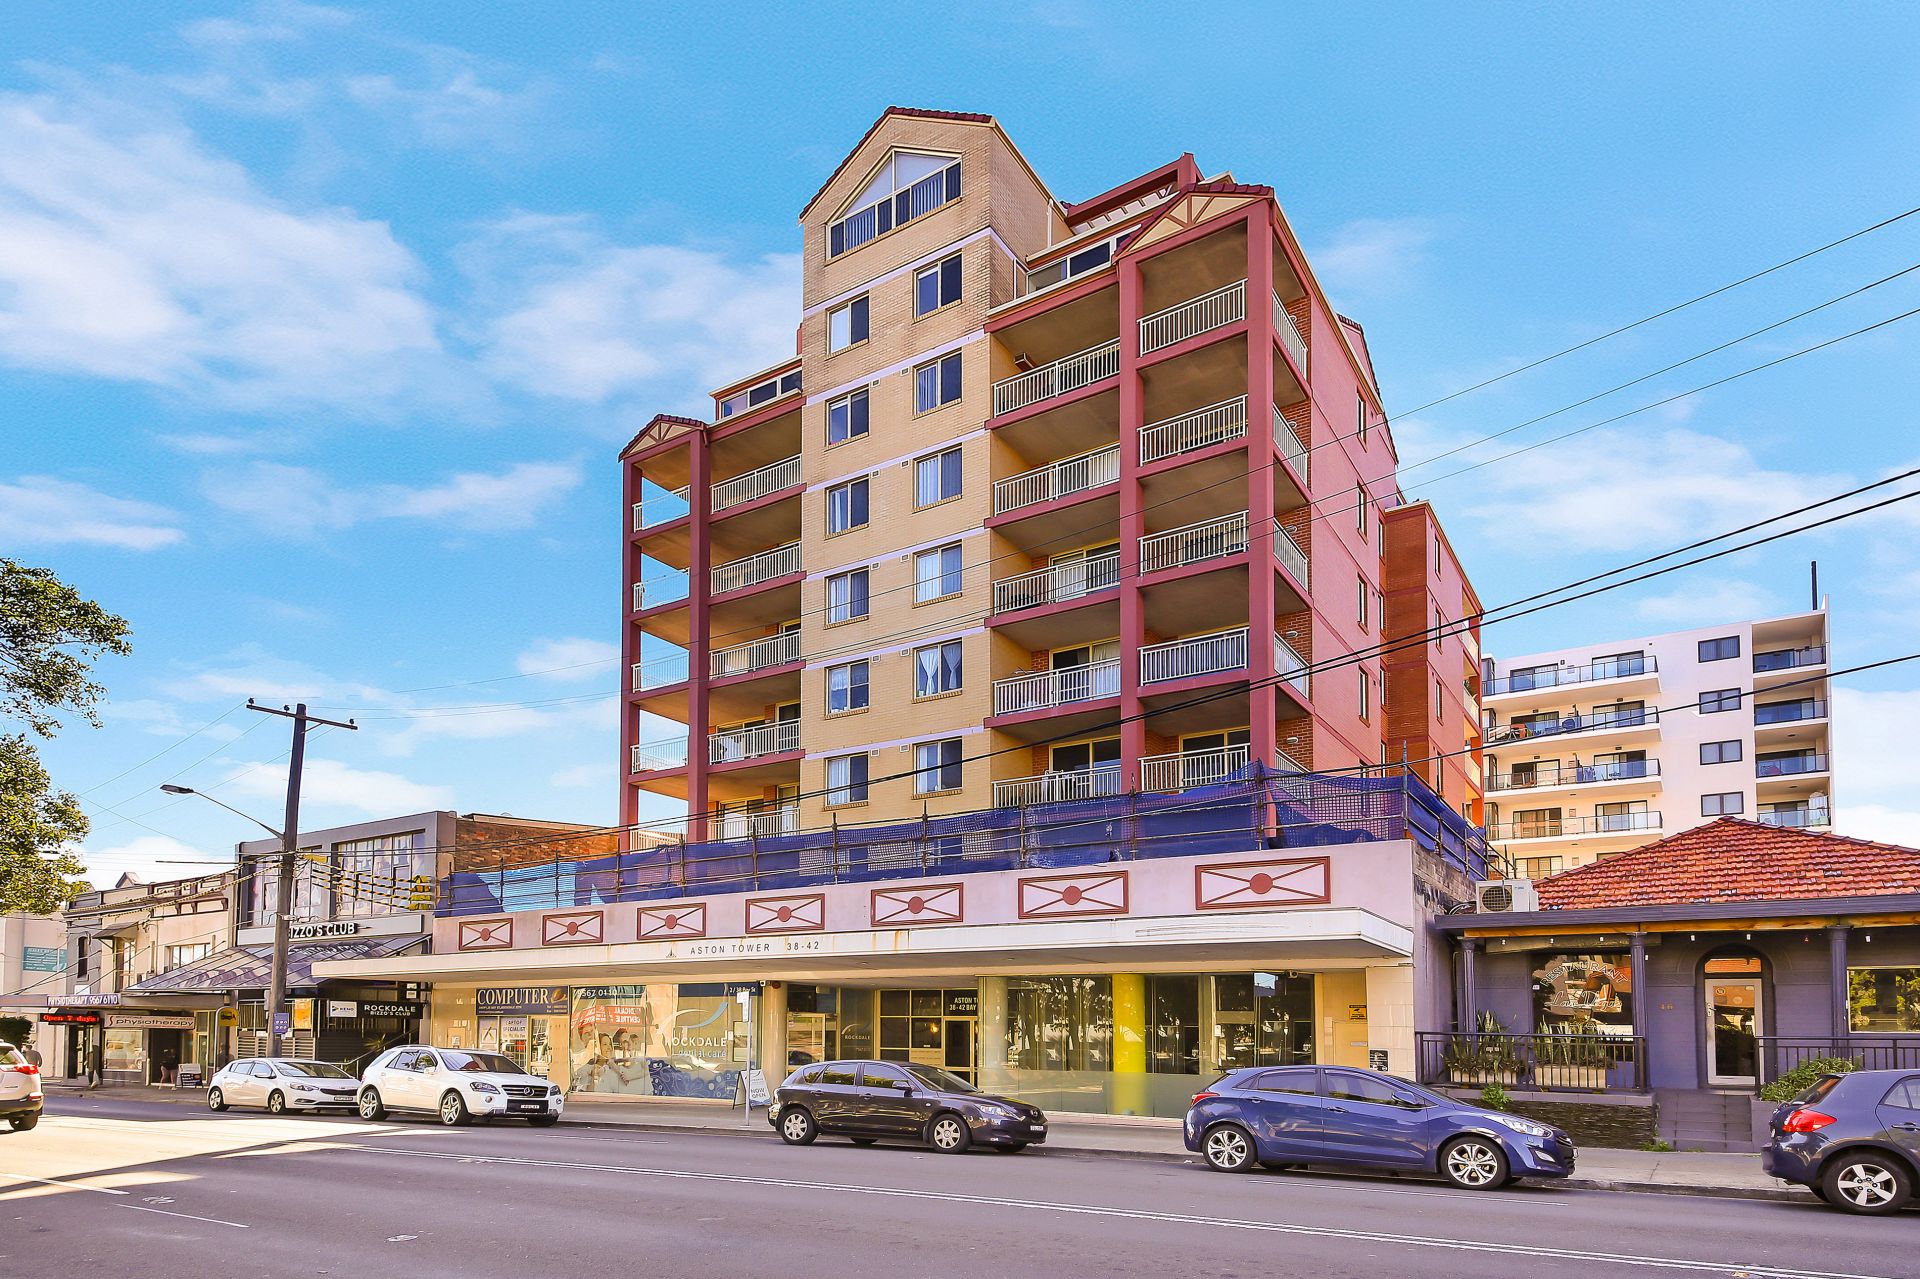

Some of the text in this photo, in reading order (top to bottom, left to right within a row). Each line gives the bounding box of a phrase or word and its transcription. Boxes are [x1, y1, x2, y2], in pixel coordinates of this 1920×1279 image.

[289, 922, 355, 939] IZZO'S CLUB
[690, 941, 819, 955] ASTON TOWER 38-42
[1540, 961, 1628, 987] RESTAURANT
[47, 995, 87, 1006] PHYSIOTHERAPY
[477, 988, 549, 1005] COMPUTER
[364, 1004, 416, 1013] ROCKDALE
[42, 1014, 65, 1022] Open
[116, 1018, 194, 1027] physiotherapy
